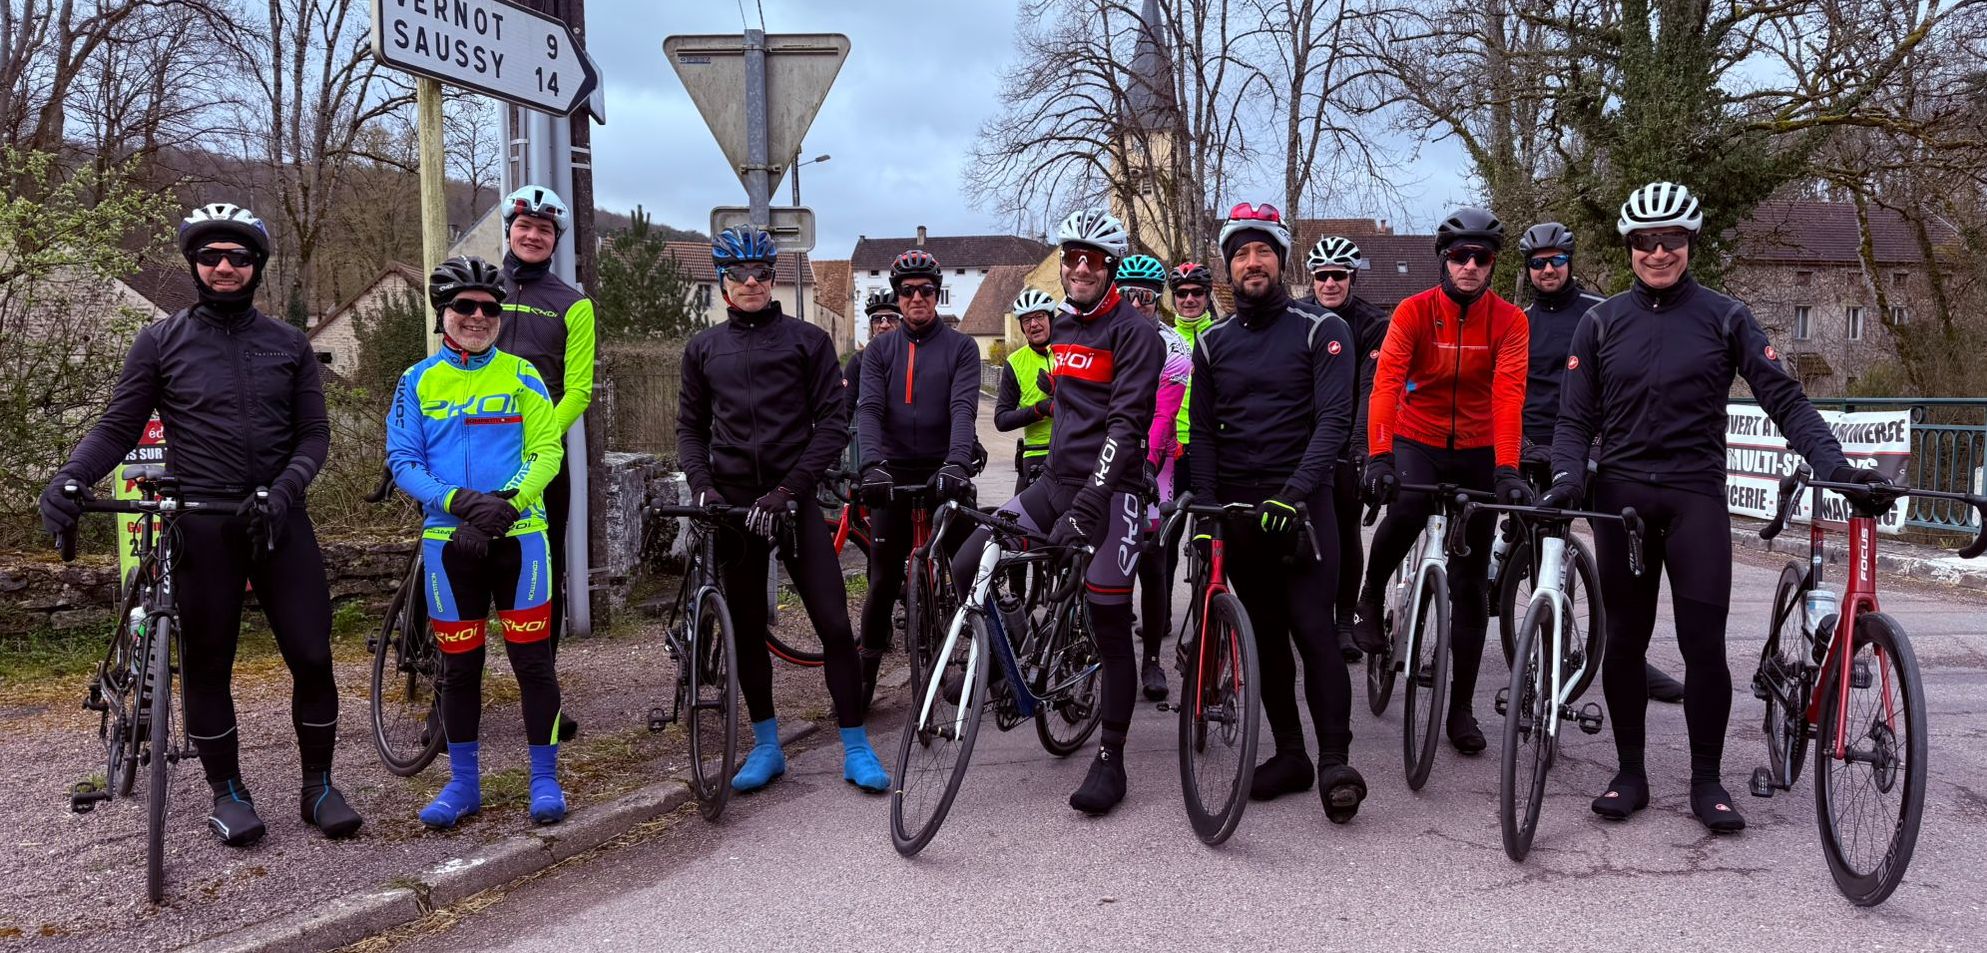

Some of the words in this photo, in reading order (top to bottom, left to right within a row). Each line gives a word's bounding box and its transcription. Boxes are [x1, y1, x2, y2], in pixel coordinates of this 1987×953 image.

[397, 0, 504, 40] ERNOT
[546, 34, 558, 60] 9
[394, 19, 504, 79] SAUSSY
[535, 67, 559, 96] 14
[1726, 415, 1762, 436] VERT
[140, 448, 163, 460] SUR
[1860, 528, 1869, 582] FOCUS
[528, 560, 539, 600] COMPETITION
